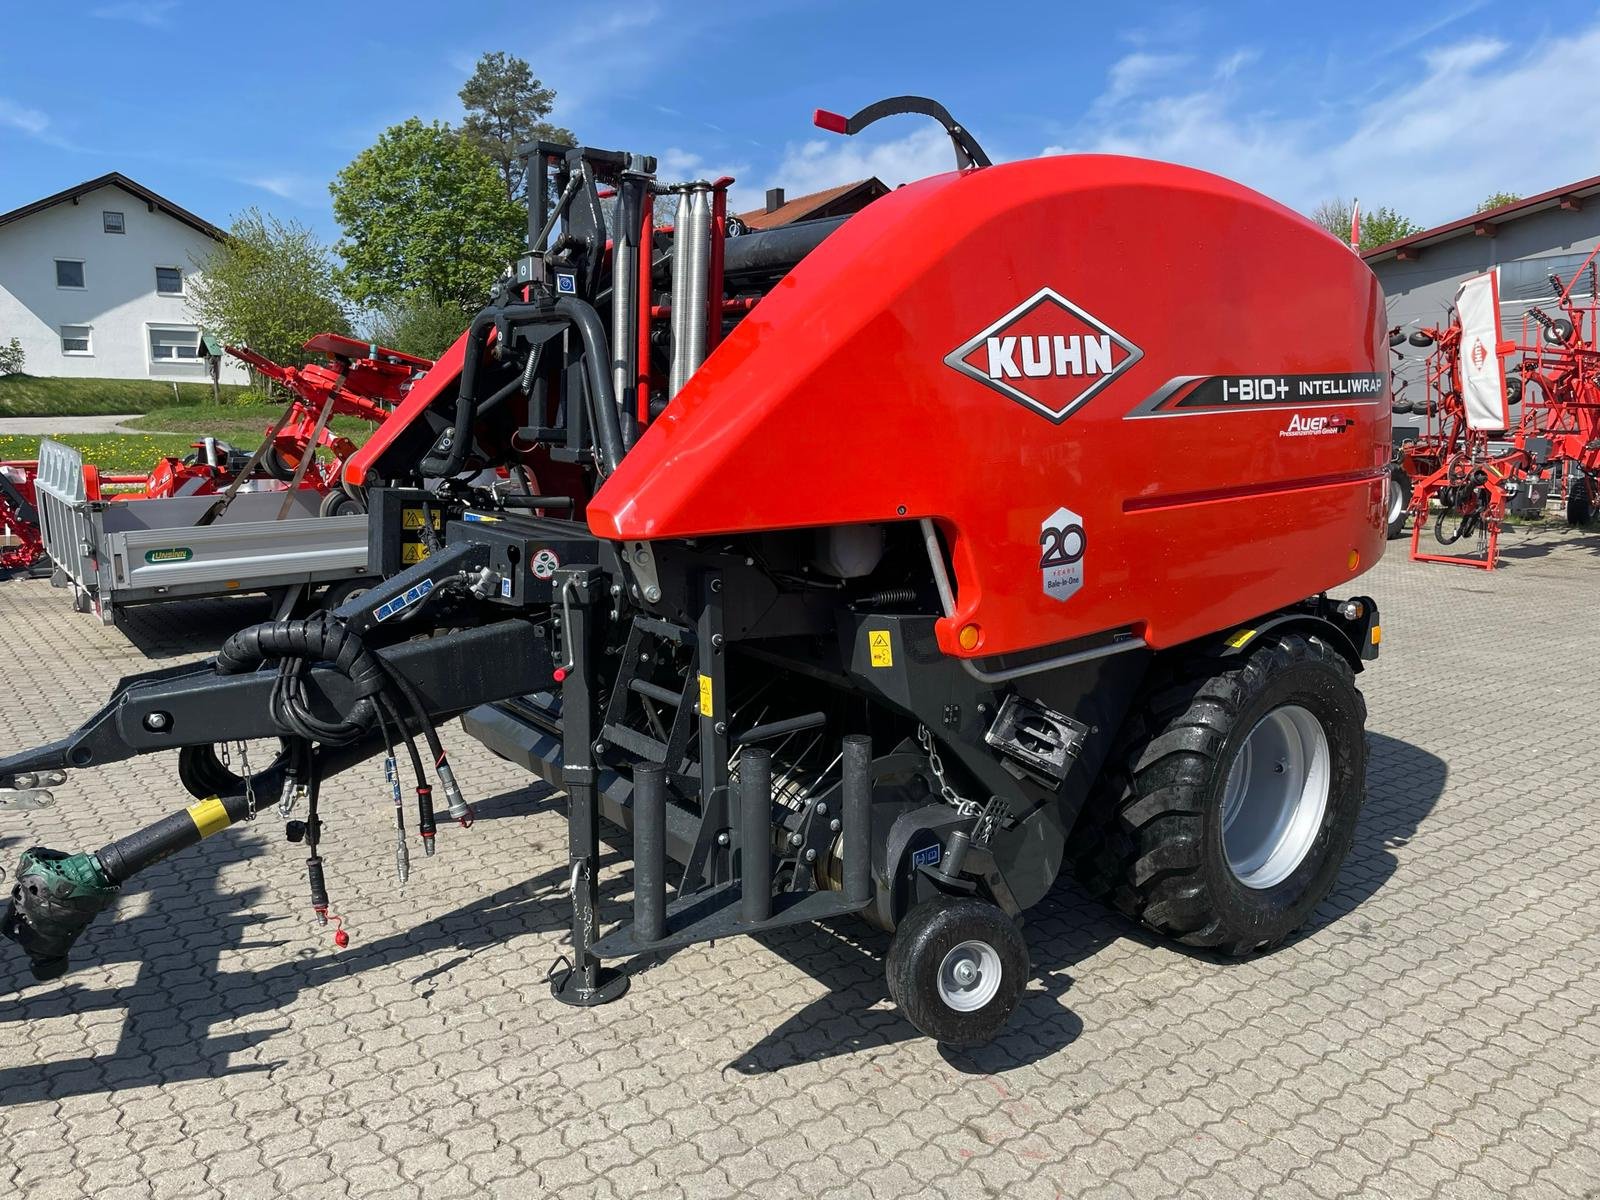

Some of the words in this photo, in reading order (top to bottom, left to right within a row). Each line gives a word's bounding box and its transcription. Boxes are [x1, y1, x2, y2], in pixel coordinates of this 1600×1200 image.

[986, 335, 1113, 379] KUHN
[1223, 379, 1289, 402] I-BIO+
[1299, 379, 1382, 395] INTELLIWRAP
[1288, 413, 1328, 432] Auer
[1321, 427, 1338, 435] GmbH
[1040, 523, 1087, 569] 20
